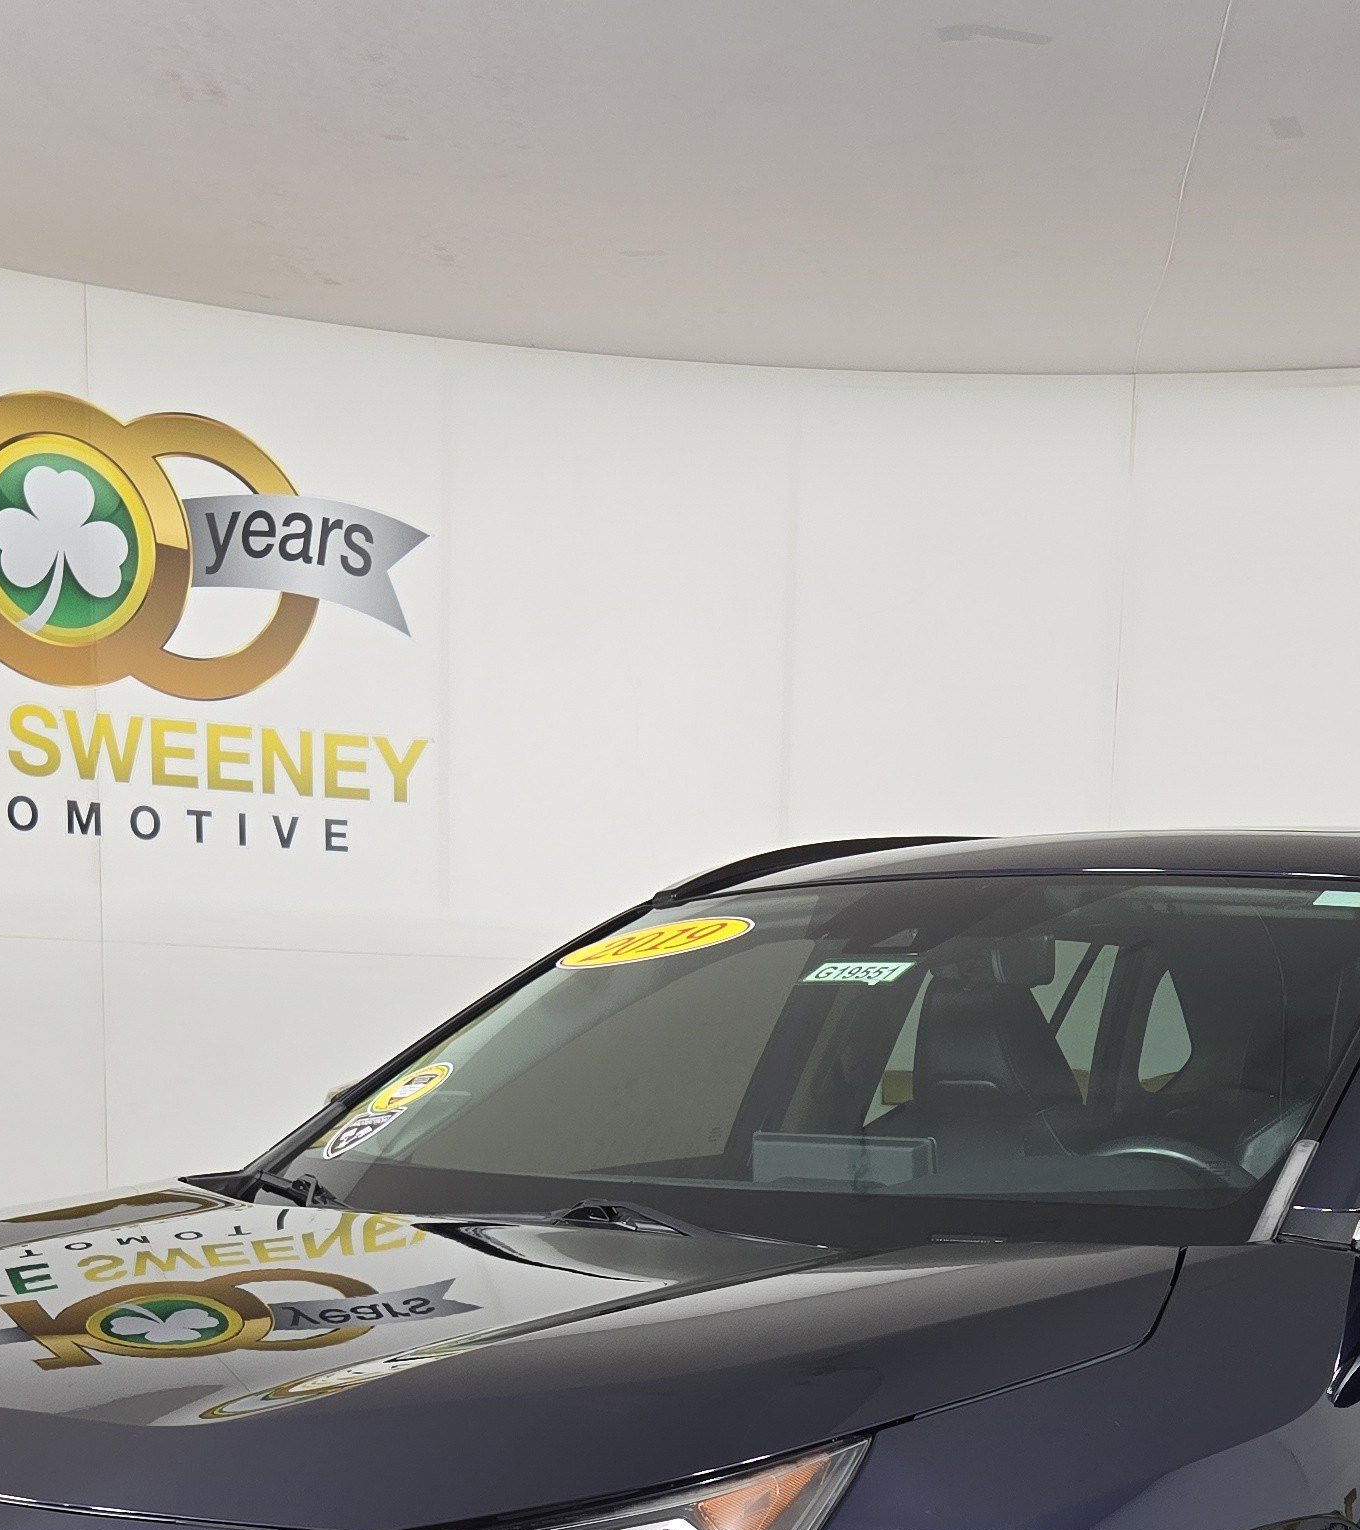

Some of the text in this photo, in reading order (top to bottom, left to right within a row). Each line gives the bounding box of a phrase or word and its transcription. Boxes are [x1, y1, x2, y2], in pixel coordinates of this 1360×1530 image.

[202, 508, 375, 578] years
[6, 702, 430, 804] SWEENEY
[576, 921, 730, 964] 2019
[814, 965, 901, 980] G19551
